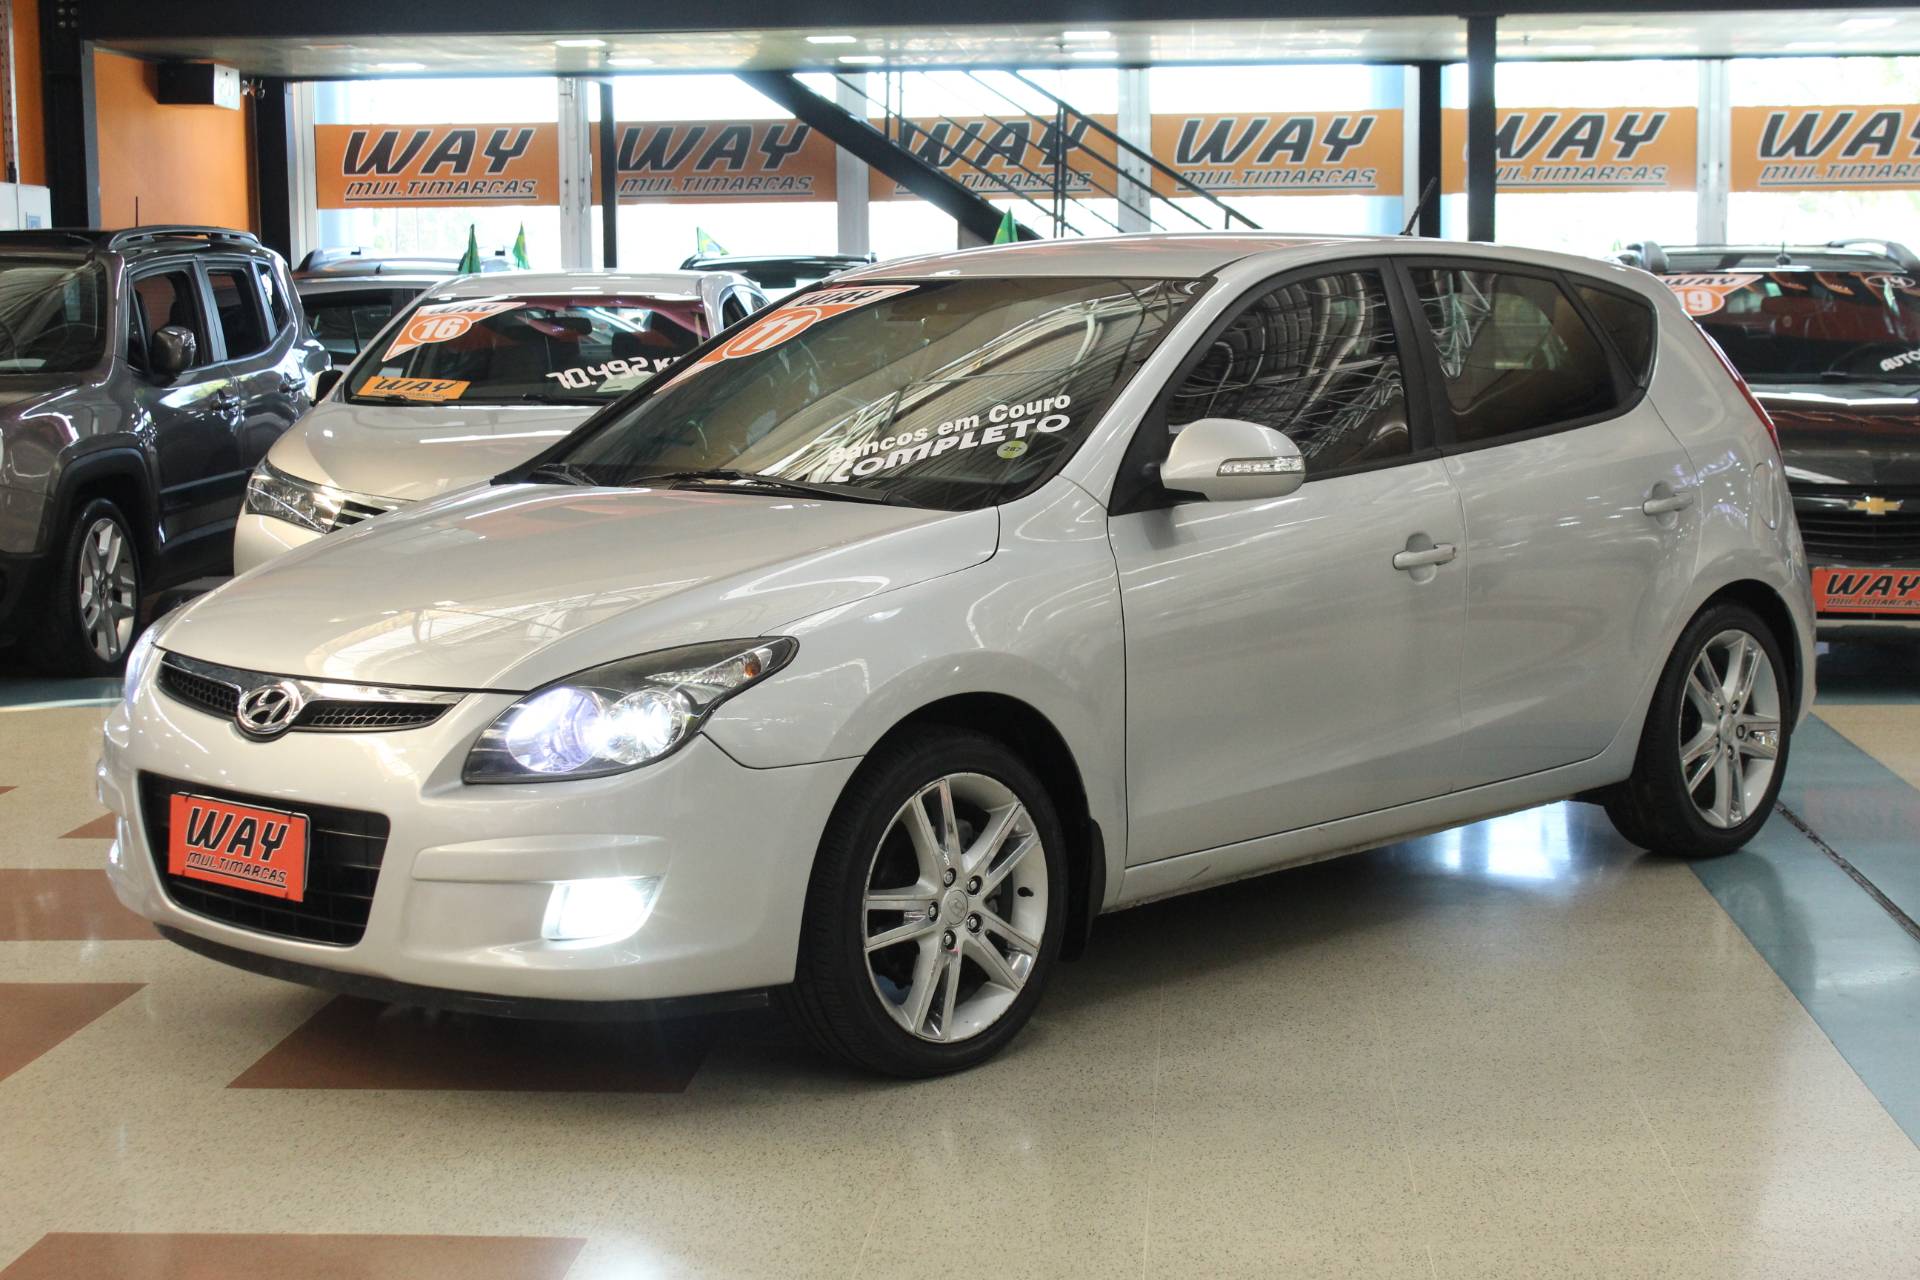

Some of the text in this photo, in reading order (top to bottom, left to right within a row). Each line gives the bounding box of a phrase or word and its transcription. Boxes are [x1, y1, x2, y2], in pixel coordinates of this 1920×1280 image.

[617, 125, 812, 171] WAY
[902, 120, 1090, 168] WAY
[1176, 116, 1377, 164] WAY
[1496, 113, 1668, 160] WAY
[1758, 110, 1920, 159] WA
[342, 128, 535, 175] WAY
[346, 180, 537, 195] MULTIMARCAS
[619, 176, 814, 192] MULTIMARCAS
[1180, 169, 1377, 185] MULTIMARCAS
[1496, 166, 1666, 180] ULTIMARCAS
[1675, 289, 1713, 311] 19
[419, 318, 465, 339] 16
[731, 314, 816, 351] 11
[653, 357, 681, 372] K
[1880, 350, 1920, 371] AUTO
[374, 379, 457, 392] WAY
[937, 413, 980, 436] em
[988, 394, 1071, 423] Couro
[829, 414, 1071, 483] COMPLETO
[1825, 574, 1920, 597] WAY
[186, 806, 289, 861] WAY
[186, 852, 288, 883] MULTIMARCAS
